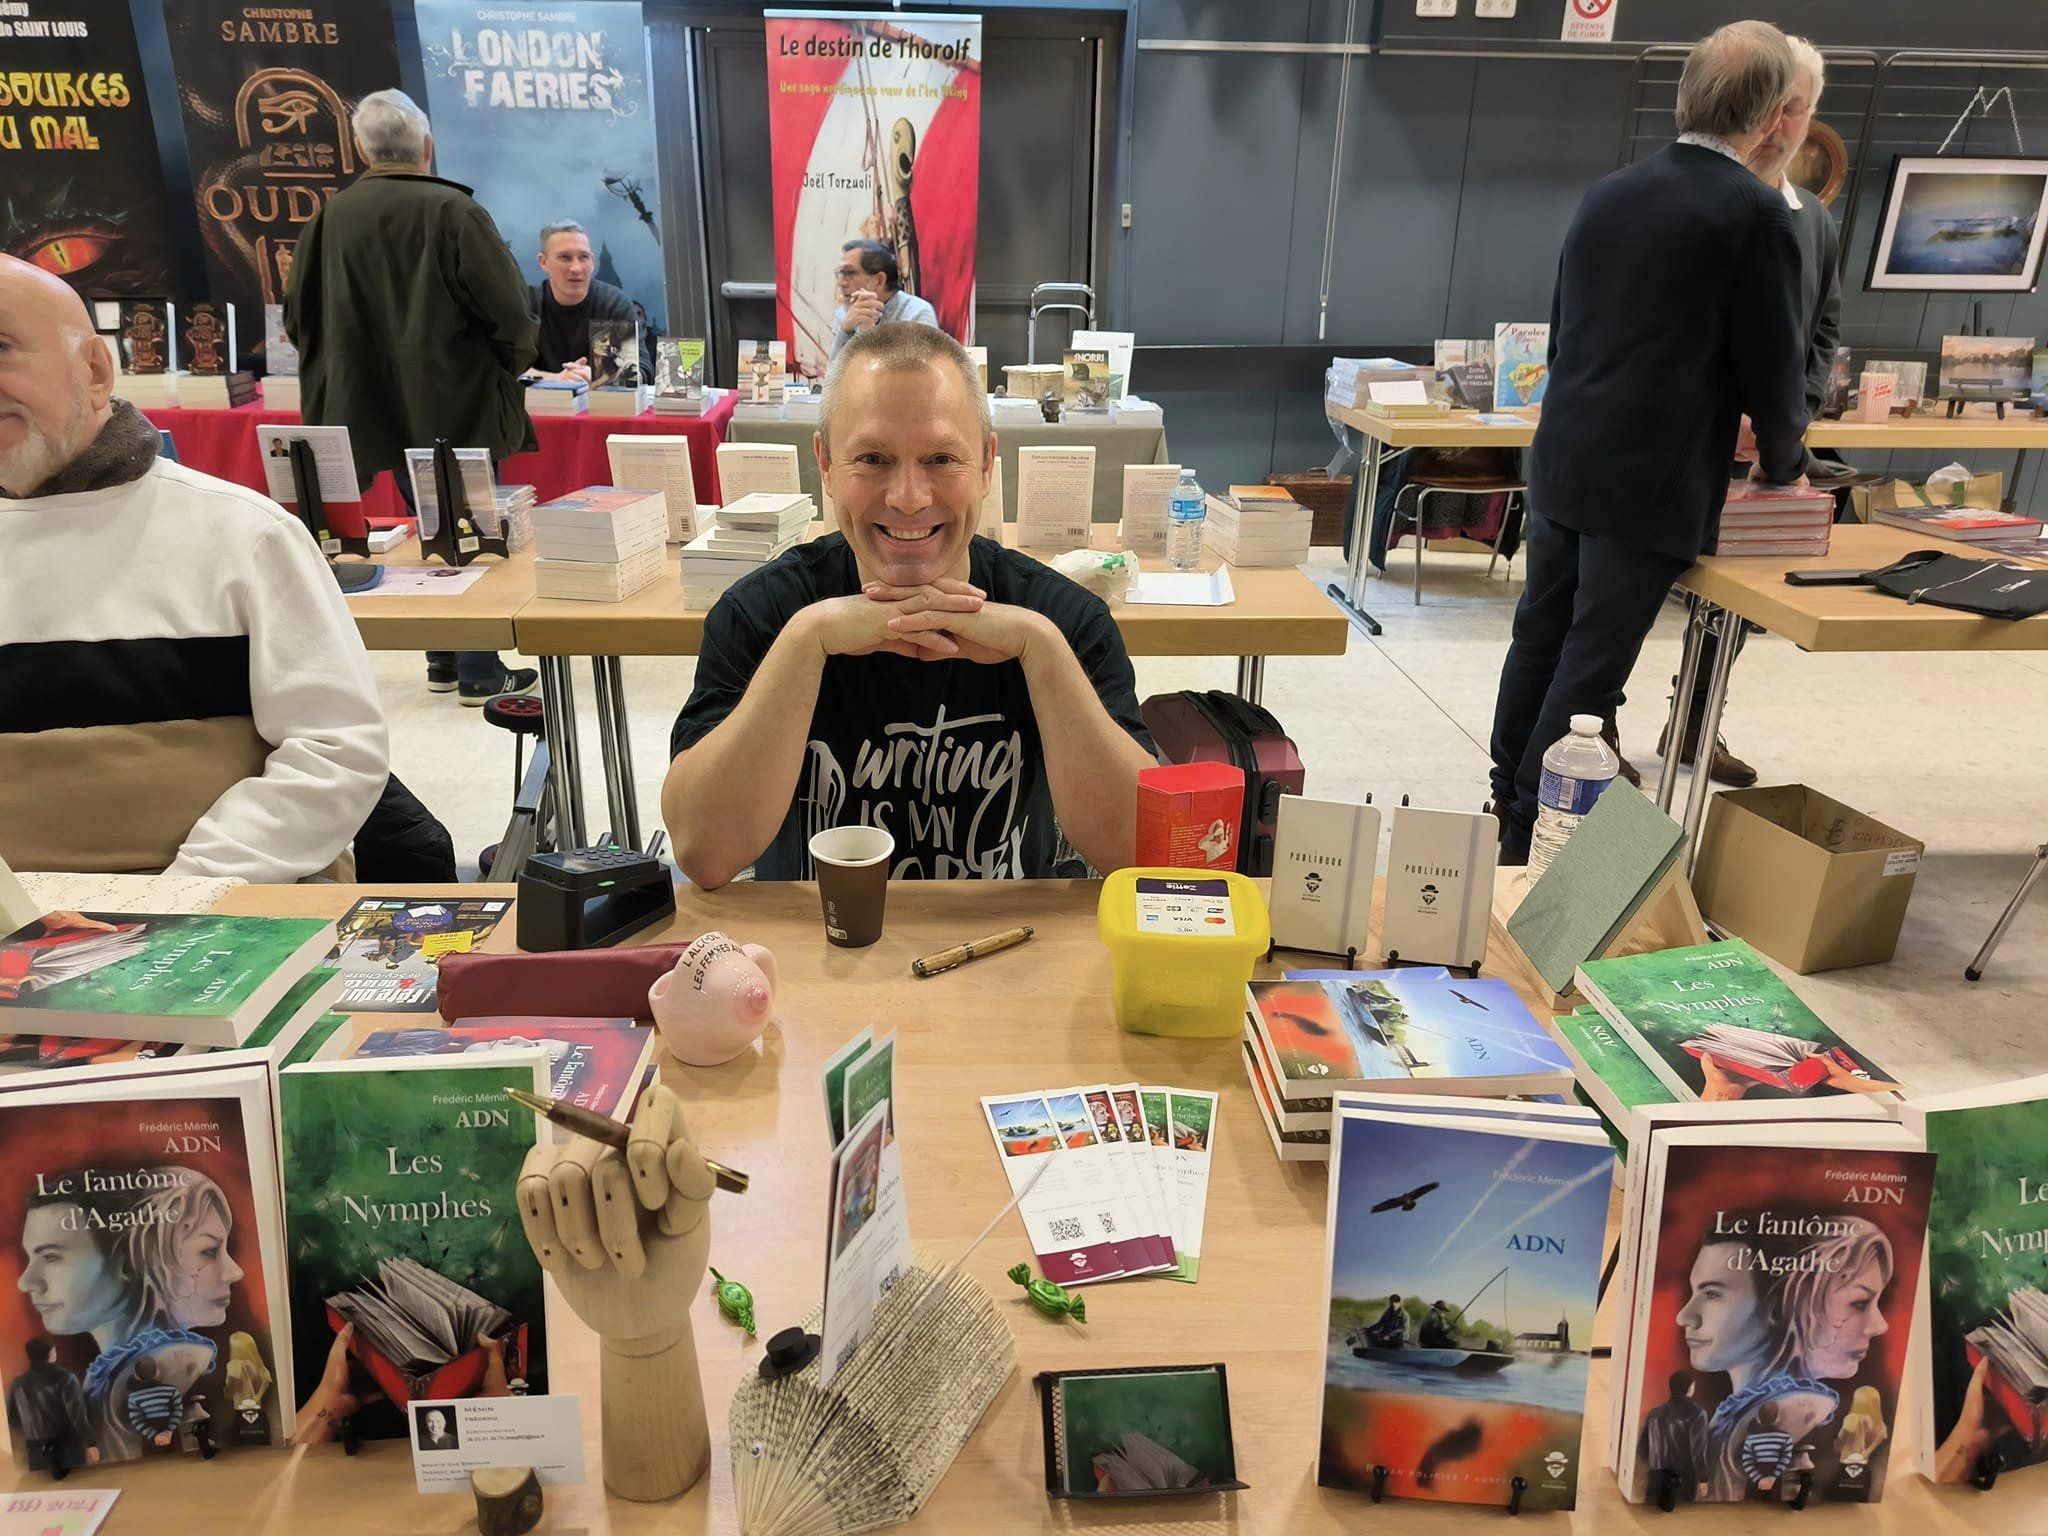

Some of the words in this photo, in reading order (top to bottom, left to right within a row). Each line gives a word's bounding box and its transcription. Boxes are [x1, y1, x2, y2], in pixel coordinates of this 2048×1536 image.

[242, 7, 313, 20] CHRISTOPHE
[476, 10, 534, 22] CHRISTOPHE
[537, 12, 577, 24] SAMBRE
[13, 21, 50, 38] SAINT
[51, 21, 89, 38] LOUIS
[221, 20, 340, 45] SAMBRE
[451, 29, 606, 70] LONDON
[779, 35, 801, 56] Le
[805, 34, 864, 58] destin
[869, 37, 893, 58] de
[897, 38, 972, 61] Thorolf
[0, 72, 131, 108] SOURCES
[463, 70, 614, 110] FAERIES
[779, 80, 797, 94] Une
[800, 81, 821, 96] saga
[905, 83, 917, 97] de
[30, 115, 100, 150] MAL
[802, 172, 825, 189] Joël
[828, 172, 872, 189] Torzuoli
[1510, 328, 1546, 338] Paroles
[1074, 353, 1105, 362] SNORRI
[853, 704, 1025, 873] writing
[861, 800, 895, 834] IS
[909, 800, 956, 851] MY
[1288, 850, 1343, 867] PUBLIBOOK
[1405, 861, 1460, 878] PUBLIBOOK
[128, 931, 217, 992] Nymphes
[189, 949, 233, 973] Les
[692, 967, 706, 992] LES
[699, 943, 731, 970] FEMMES
[1707, 957, 1745, 970] ADN
[192, 976, 228, 1003] ADN
[397, 977, 417, 990] &
[1671, 979, 1716, 993] Les
[376, 987, 425, 1004] Fête
[1659, 992, 1765, 1016] Nymphes
[1589, 1024, 1618, 1048] ADN
[570, 1045, 594, 1060] Le
[1464, 1035, 1491, 1061] ADN
[432, 1093, 474, 1105] Frédéric
[475, 1092, 510, 1103] Mémin
[572, 1091, 591, 1109] AD
[139, 1121, 183, 1134] Frédéric
[184, 1121, 220, 1131] Mémin
[455, 1109, 511, 1129] ADN
[164, 1136, 222, 1153] ADN
[385, 1146, 444, 1175] Les
[36, 1173, 75, 1196] Le
[85, 1168, 192, 1192] fantôme
[1492, 1169, 1536, 1184] Frédéric
[1825, 1169, 1870, 1182] Frédéric
[1871, 1171, 1907, 1183] Mémin
[1842, 1187, 1905, 1206] ADN
[60, 1202, 180, 1234] d'Agathe
[342, 1191, 493, 1229] Nymphes
[1714, 1211, 1749, 1234] Le
[1757, 1211, 1863, 1238] fantôme
[1506, 1233, 1566, 1255] ADN
[1727, 1249, 1841, 1276] d'Agathe
